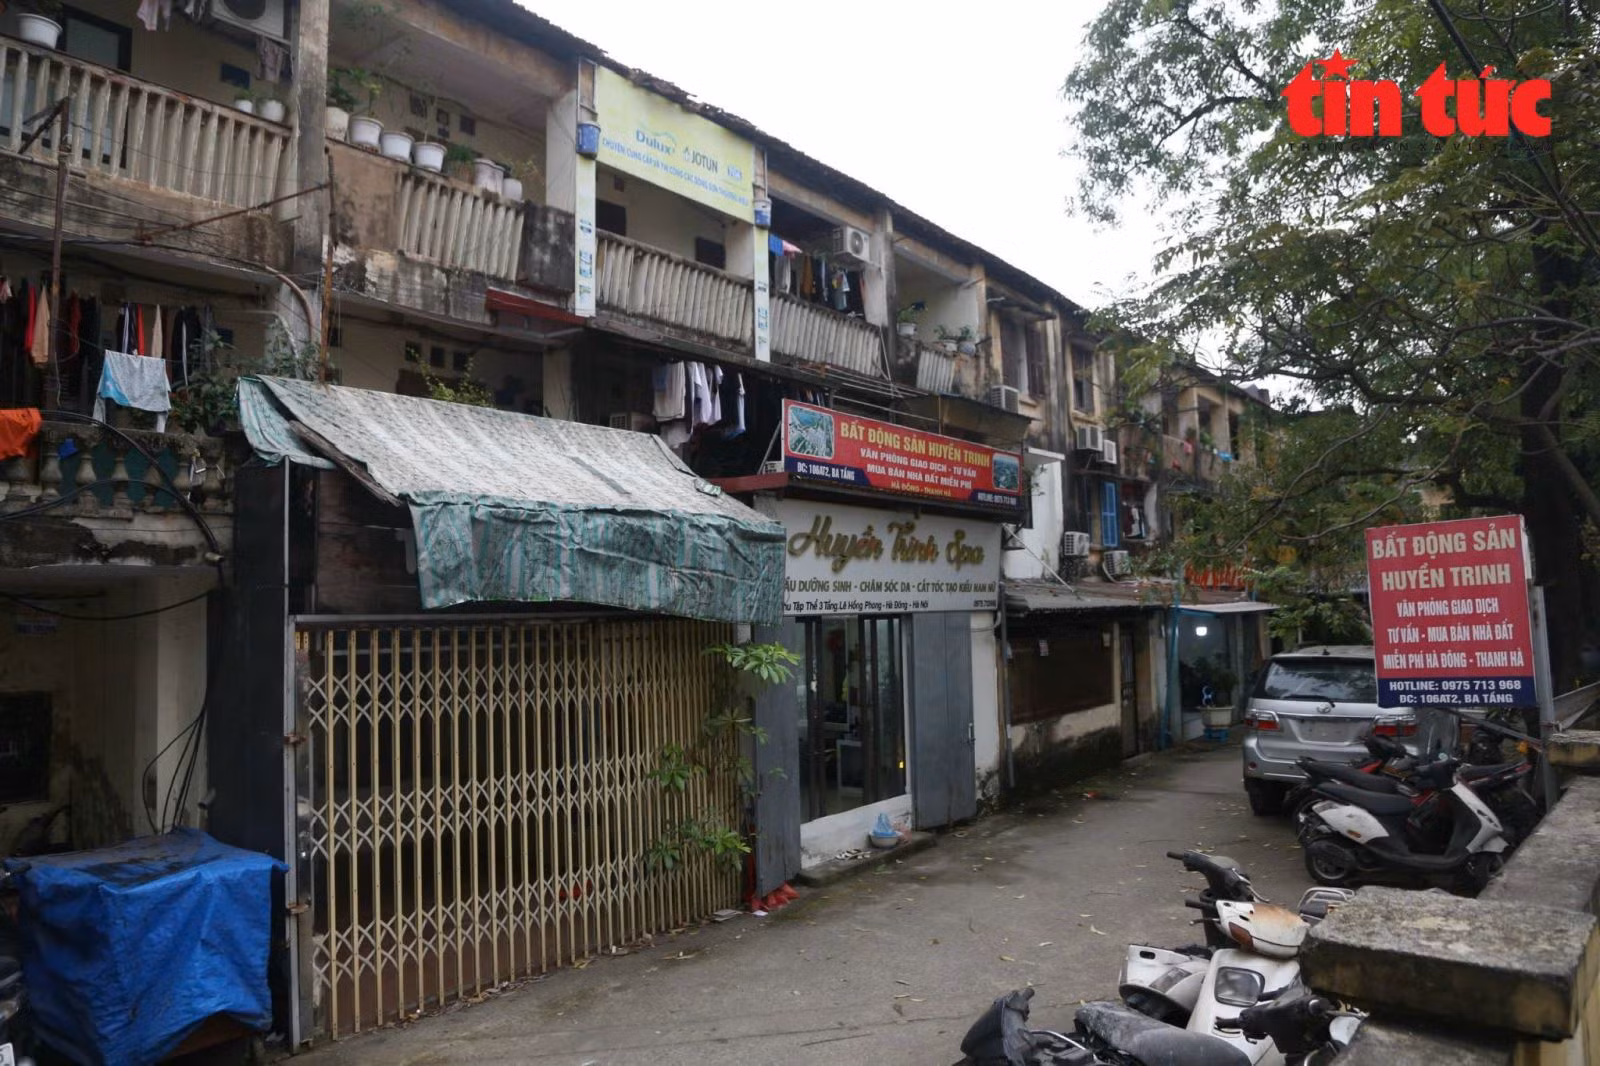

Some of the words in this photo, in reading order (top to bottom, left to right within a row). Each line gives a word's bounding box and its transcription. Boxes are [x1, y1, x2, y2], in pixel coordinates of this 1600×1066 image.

[635, 128, 671, 155] Dulux
[692, 150, 718, 174] JOTUN
[840, 420, 865, 441] BẤT
[868, 427, 901, 449] ĐỘNG
[903, 434, 926, 454] SẢN
[964, 450, 990, 467] TRINH
[860, 447, 879, 460] VĂN
[880, 451, 908, 466] PHÒNG
[910, 458, 928, 469] GIAO
[929, 460, 947, 473] DỊCH
[866, 463, 886, 475] MUA
[888, 466, 905, 478] BÁN
[907, 469, 923, 482] NHÀ
[887, 520, 939, 562] Trinh
[945, 528, 985, 571] Spa
[1371, 531, 1407, 560] BẤT
[1412, 531, 1467, 560] ĐỘNG
[1472, 522, 1516, 551] SẢN
[784, 576, 796, 593] ẦU
[798, 577, 830, 593] DƯỠNG
[832, 580, 852, 593] SINH
[859, 578, 882, 593] CHĂM
[884, 578, 898, 593] SÓC
[900, 582, 911, 593] DA
[917, 578, 932, 593] CẮT
[932, 579, 945, 593] TÓC
[945, 582, 958, 595] TẠO
[1449, 563, 1511, 587] TRINH
[792, 601, 804, 613] Tập
[819, 601, 824, 610] 3
[839, 601, 847, 610] Lê
[864, 600, 882, 611] Phong
[1396, 598, 1416, 618] VĂN
[1417, 597, 1450, 617] PHÒNG
[1451, 599, 1473, 615] GIAO
[1475, 597, 1499, 617] DỊCH
[1387, 627, 1399, 644] TƯ
[1400, 622, 1419, 643] VẤN
[1427, 626, 1449, 642] MUA
[1450, 622, 1470, 642] BÁN
[1472, 621, 1493, 641] NHÀ
[1494, 618, 1514, 640] ĐẤT
[1382, 648, 1406, 669] MIỄN
[1407, 650, 1424, 669] PHÍ
[1425, 649, 1439, 668] HÀ
[1440, 649, 1467, 668] ĐÔNG
[1475, 651, 1508, 668] THANH
[1509, 647, 1524, 667] HÀ
[1389, 681, 1439, 691] HOTLINE:
[1441, 680, 1470, 690] 0975
[1473, 680, 1496, 690] 713
[1498, 680, 1522, 690] 968
[1399, 694, 1417, 703] ĐC:
[1420, 693, 1462, 704] 106AT2,
[1464, 693, 1480, 703] BA
